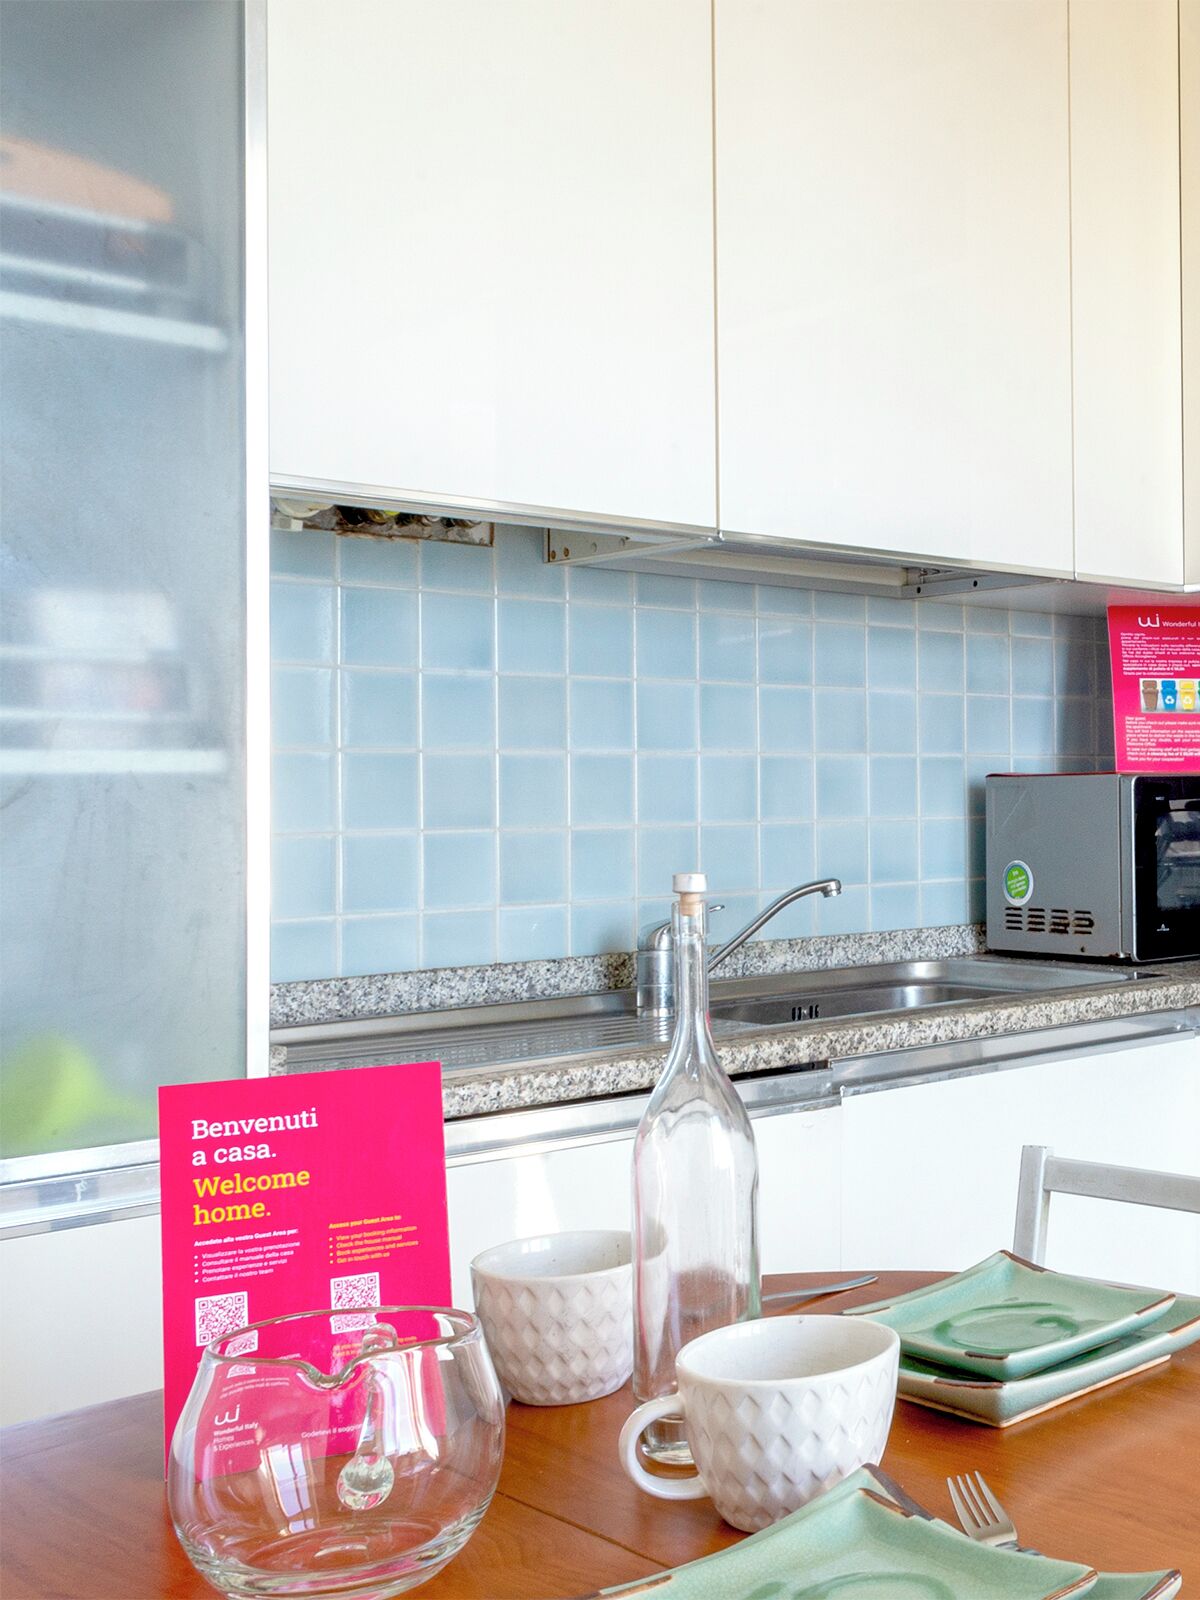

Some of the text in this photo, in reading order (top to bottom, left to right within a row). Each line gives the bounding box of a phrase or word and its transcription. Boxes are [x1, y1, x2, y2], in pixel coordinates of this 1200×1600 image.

[191, 1107, 318, 1140] Benvenuti
[192, 1143, 277, 1166] a casa.
[193, 1170, 310, 1198] Welcome
[193, 1202, 271, 1226] home.
[329, 1221, 349, 1229] Access
[363, 1230, 385, 1238] booking
[194, 1238, 223, 1247] Accedete
[202, 1250, 237, 1259] Visualizzare
[263, 1242, 300, 1251] prenotazione
[202, 1258, 234, 1267] Consultare
[202, 1266, 231, 1274] Prenotare
[202, 1274, 234, 1282] Contattare
[214, 1421, 259, 1436] Wonderful Italy
